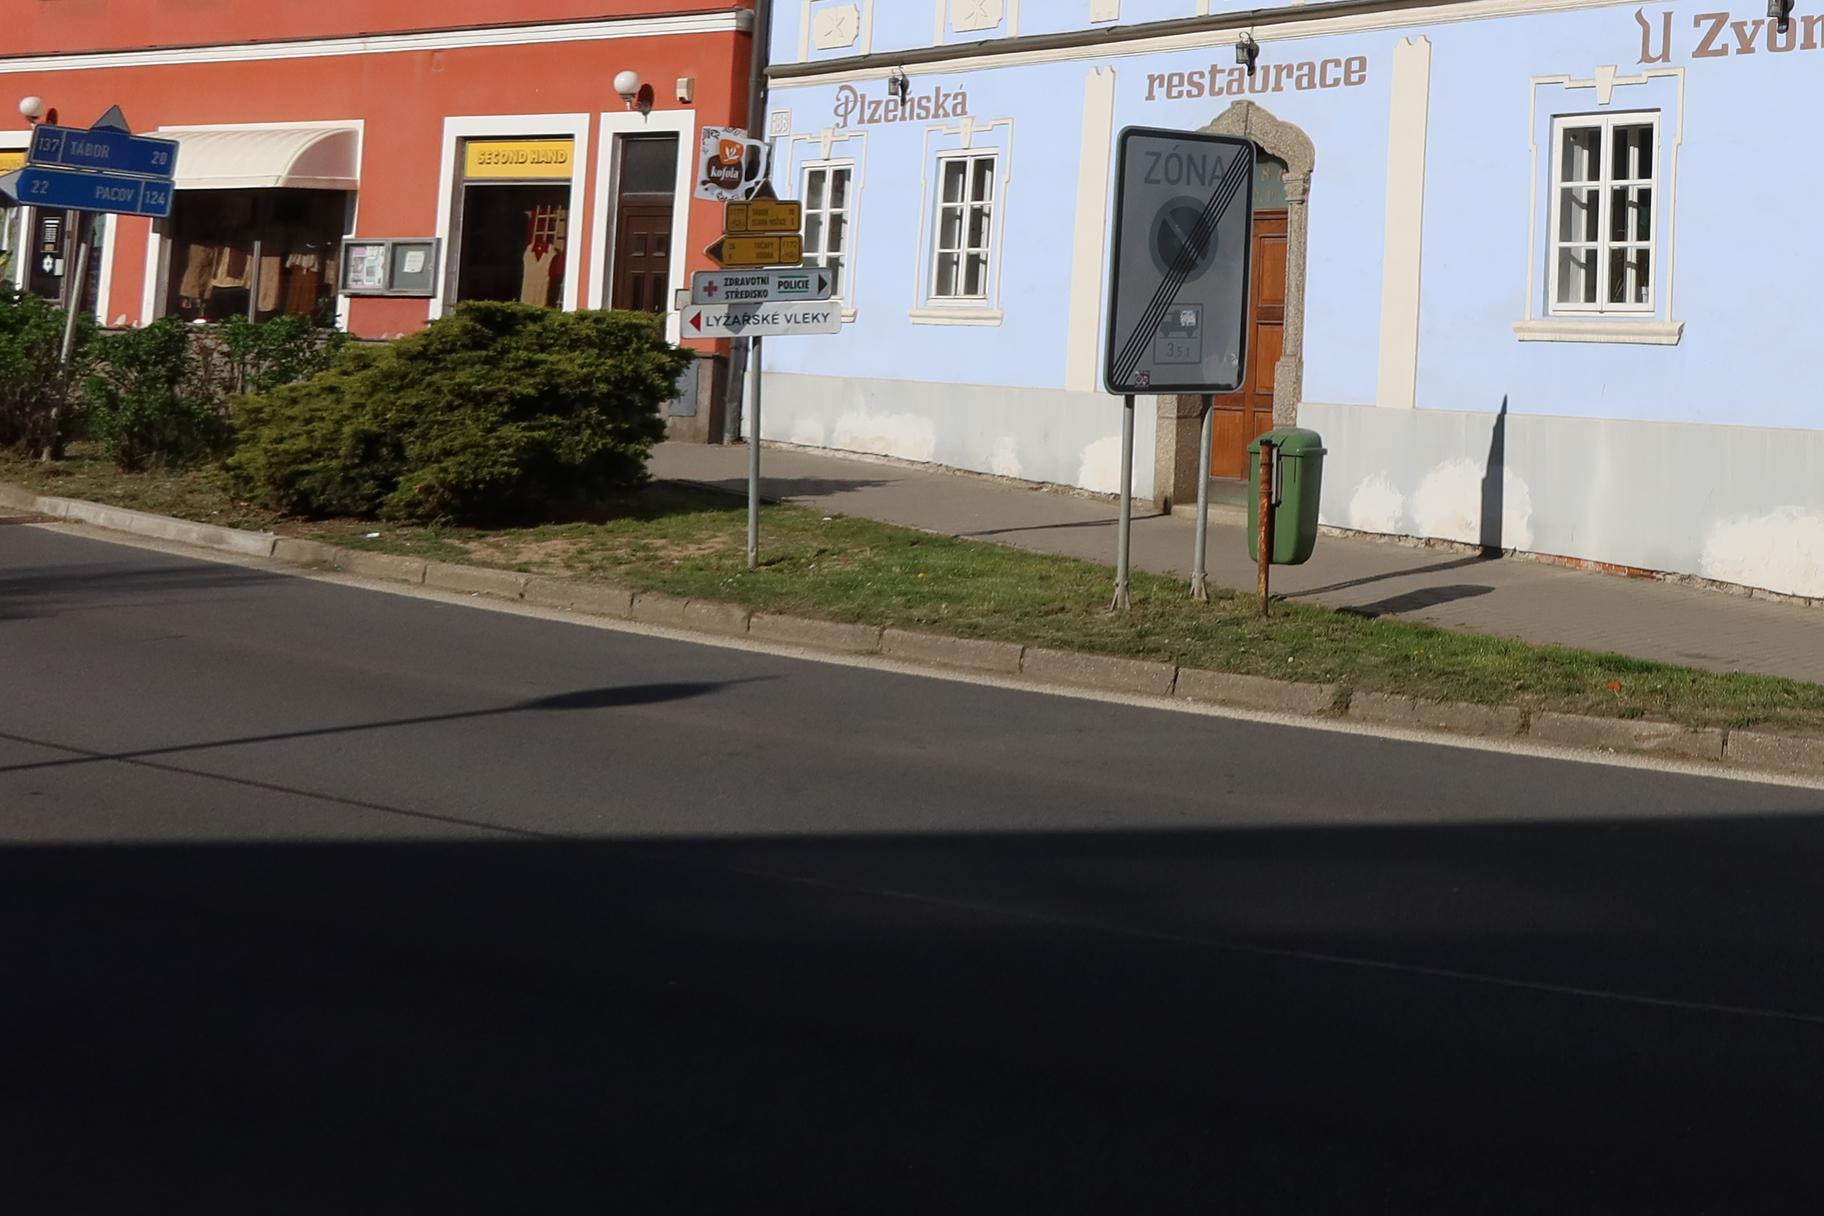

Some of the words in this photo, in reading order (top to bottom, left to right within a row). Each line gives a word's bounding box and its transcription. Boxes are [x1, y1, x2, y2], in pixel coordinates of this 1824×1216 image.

[1634, 7, 1675, 65] U
[1145, 55, 1368, 102] restaurace
[833, 84, 969, 128] Plzeňská
[38, 137, 61, 153] 137
[70, 141, 110, 159] TÁBOR
[151, 151, 168, 165] 20
[479, 150, 528, 165] SECOND
[529, 149, 568, 164] HAND
[1144, 144, 1228, 186] ZÓNA
[31, 179, 49, 194] 22
[96, 185, 135, 202] PACOV
[145, 190, 166, 205] 124
[723, 274, 770, 288] ZDRAVOTNÍ
[777, 279, 810, 290] POLICIE
[724, 287, 769, 300] STŘEDISKO
[706, 312, 780, 327] LYŽAŘSKÉ
[784, 312, 831, 325] VLEKY
